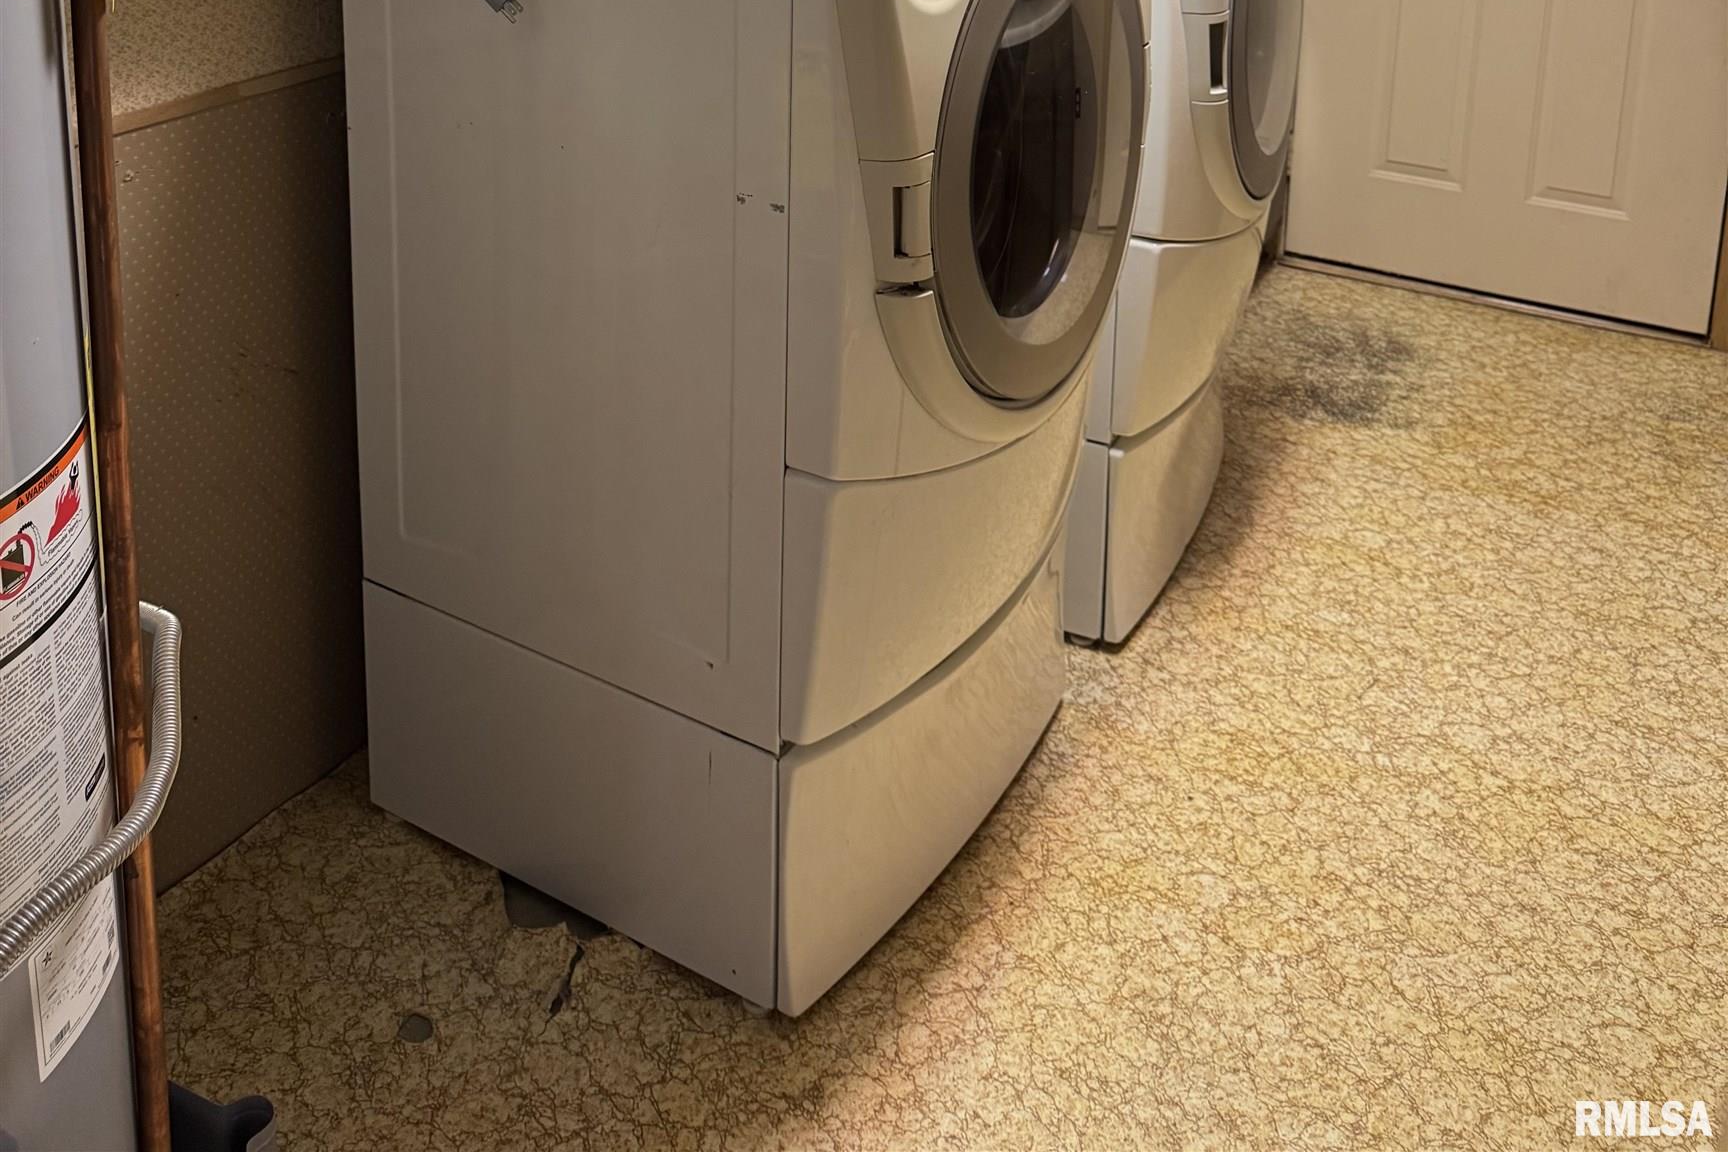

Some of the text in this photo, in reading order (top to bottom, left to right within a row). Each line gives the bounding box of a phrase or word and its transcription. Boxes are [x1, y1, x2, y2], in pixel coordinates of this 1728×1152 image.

[25, 466, 60, 502] WARNING
[28, 587, 36, 598] AND
[37, 568, 58, 590] EXPLOSION
